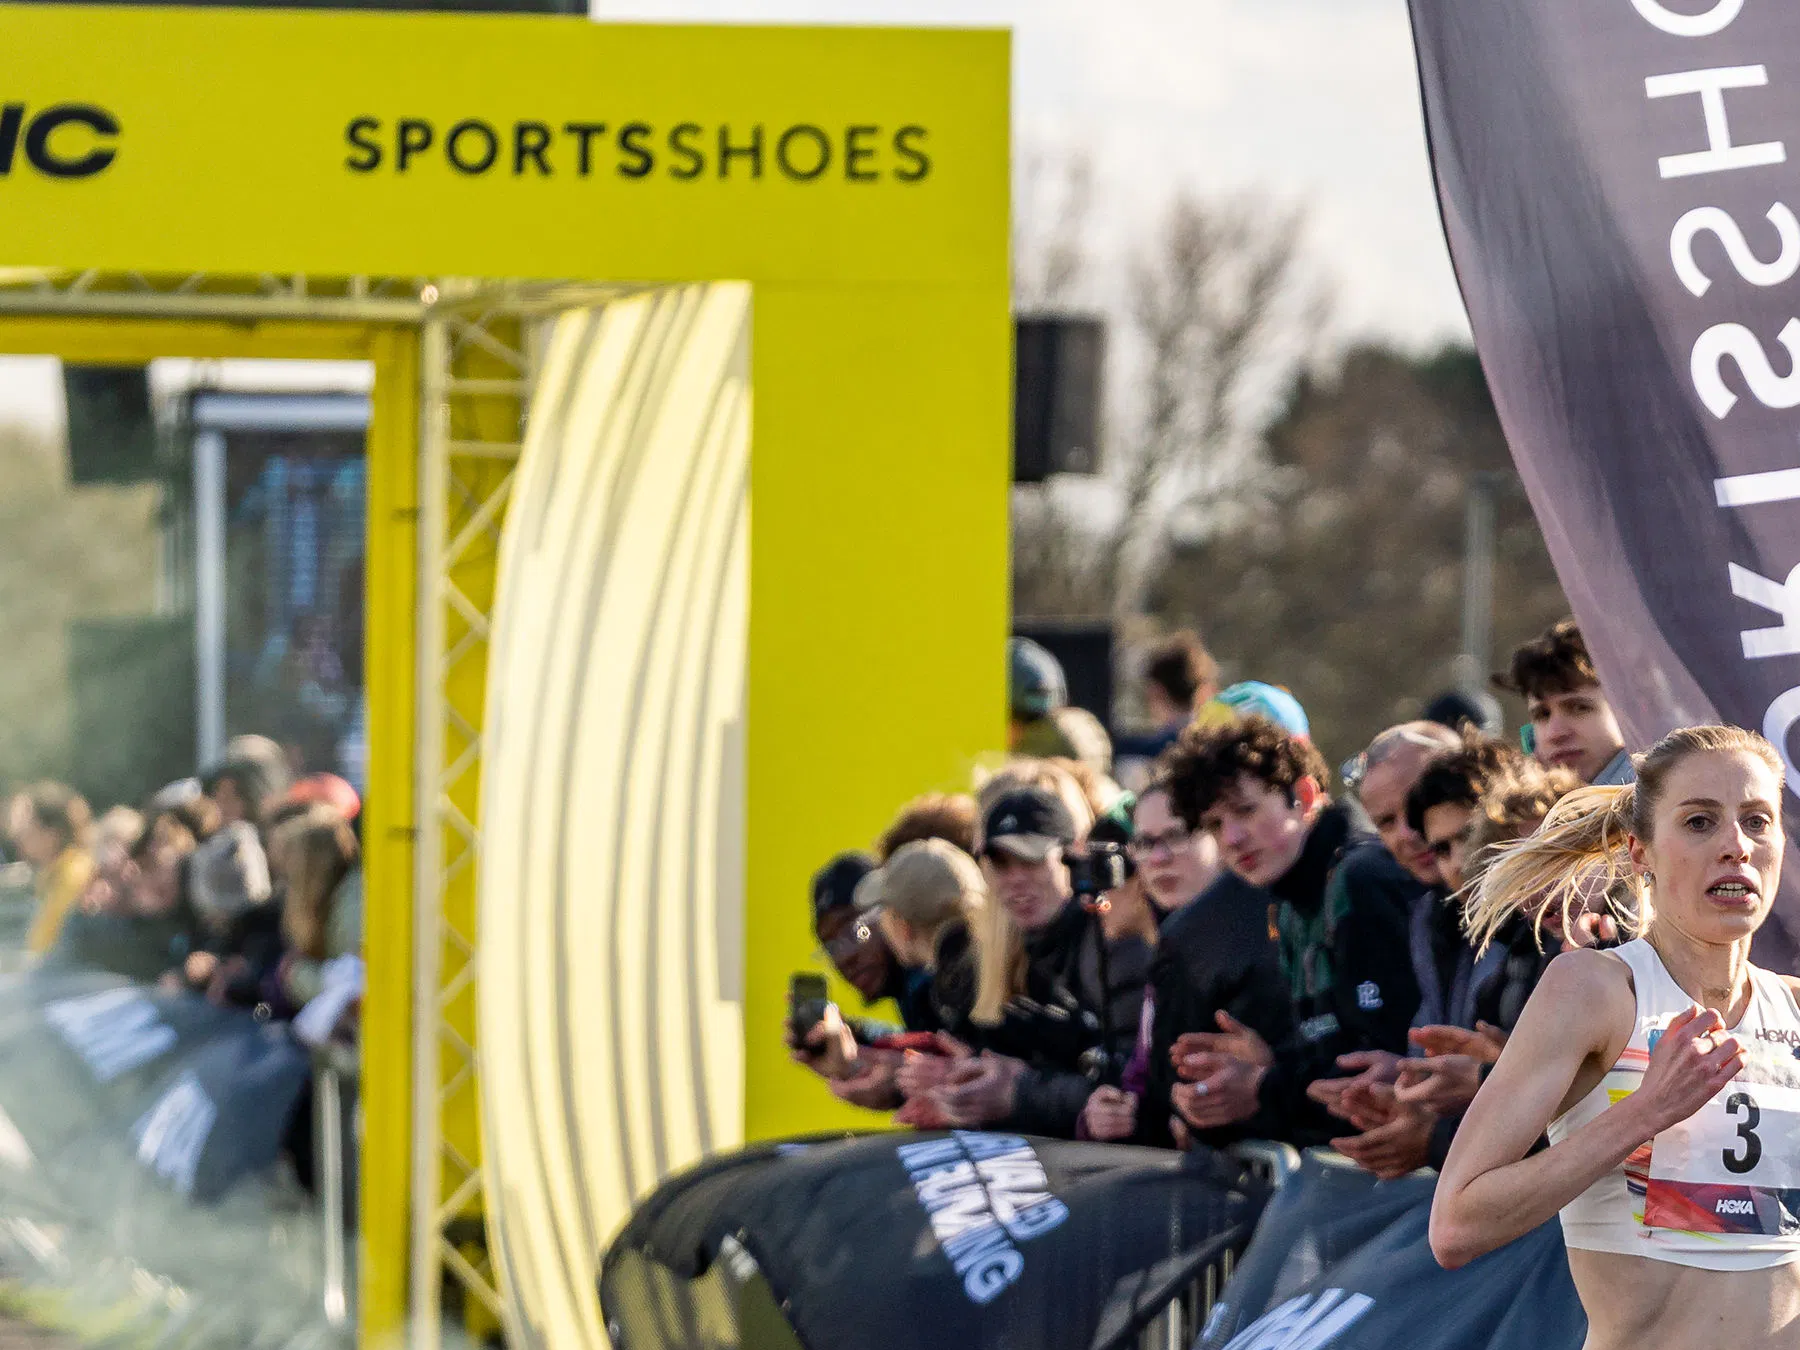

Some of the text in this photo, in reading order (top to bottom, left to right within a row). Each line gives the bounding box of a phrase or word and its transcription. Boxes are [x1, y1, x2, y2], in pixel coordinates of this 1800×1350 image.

[343, 114, 932, 184] SPORTSSHOES
[1722, 1092, 1762, 1174] 3
[1715, 1199, 1755, 1215] HOKA
